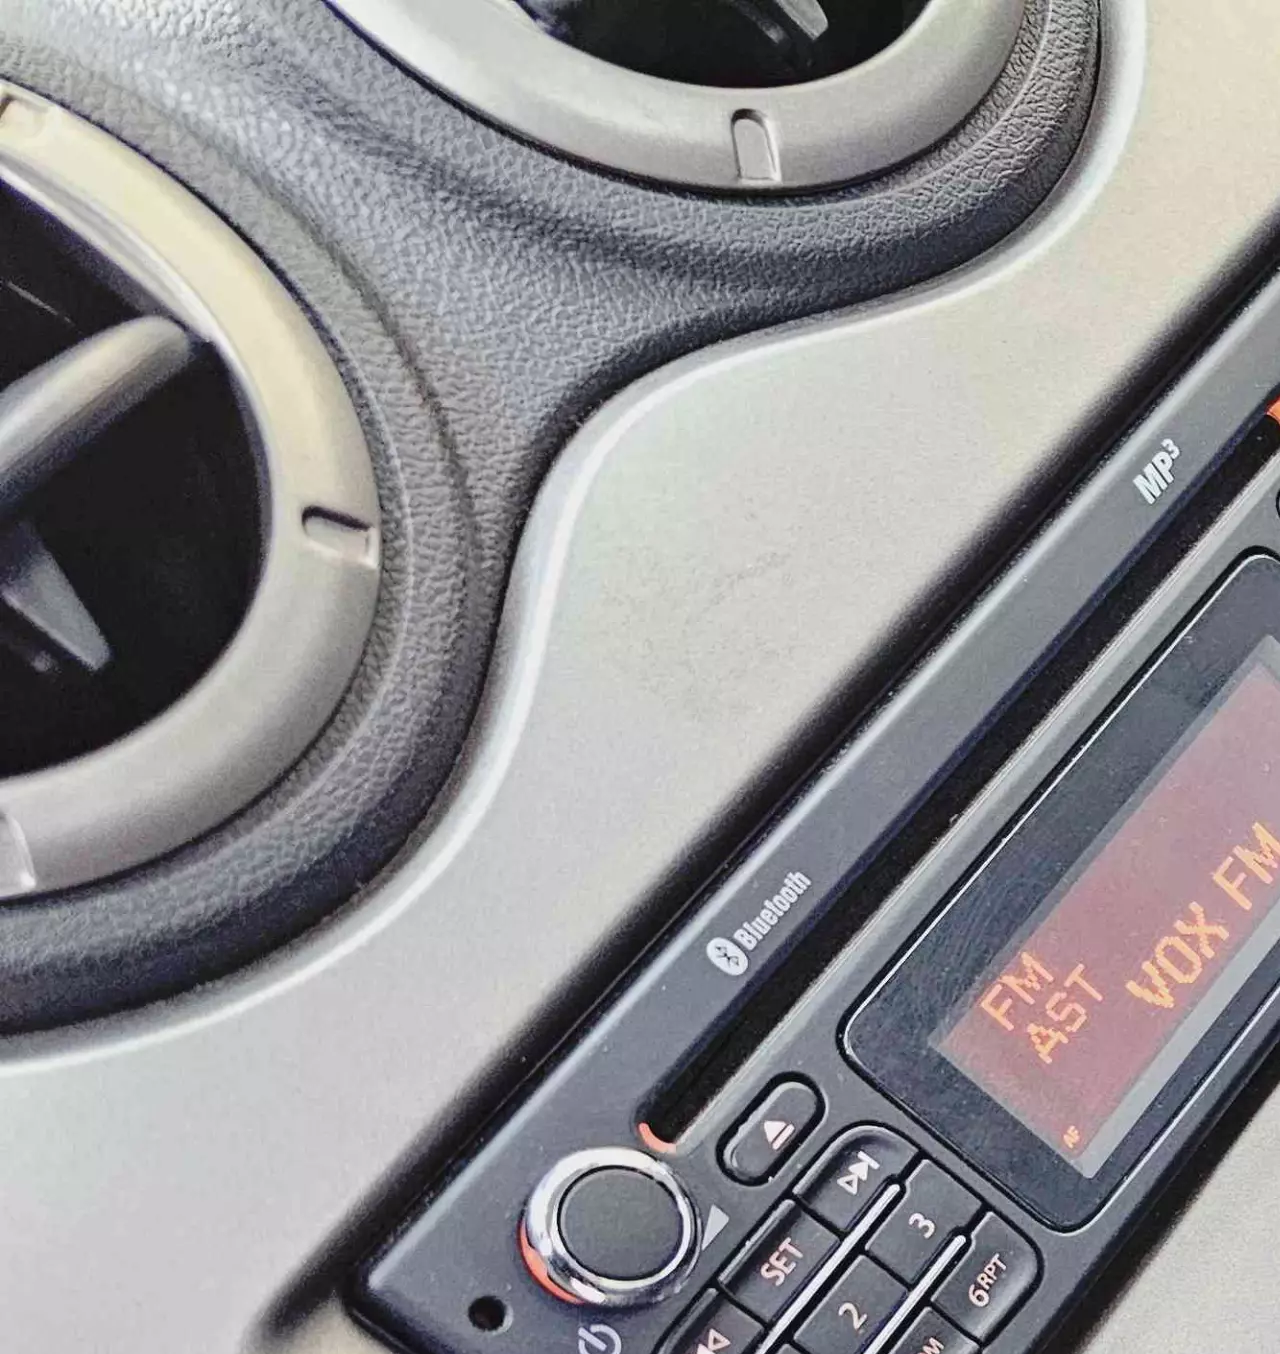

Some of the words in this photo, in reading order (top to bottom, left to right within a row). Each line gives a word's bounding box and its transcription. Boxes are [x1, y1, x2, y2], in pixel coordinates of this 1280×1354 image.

[733, 871, 812, 951] Bluetooth
[981, 952, 1054, 1031] FM
[1125, 901, 1230, 1009] VOX
[1027, 963, 1103, 1064] AST
[760, 1237, 803, 1286] SET
[908, 1213, 936, 1239] 3
[838, 1302, 868, 1330] 2
